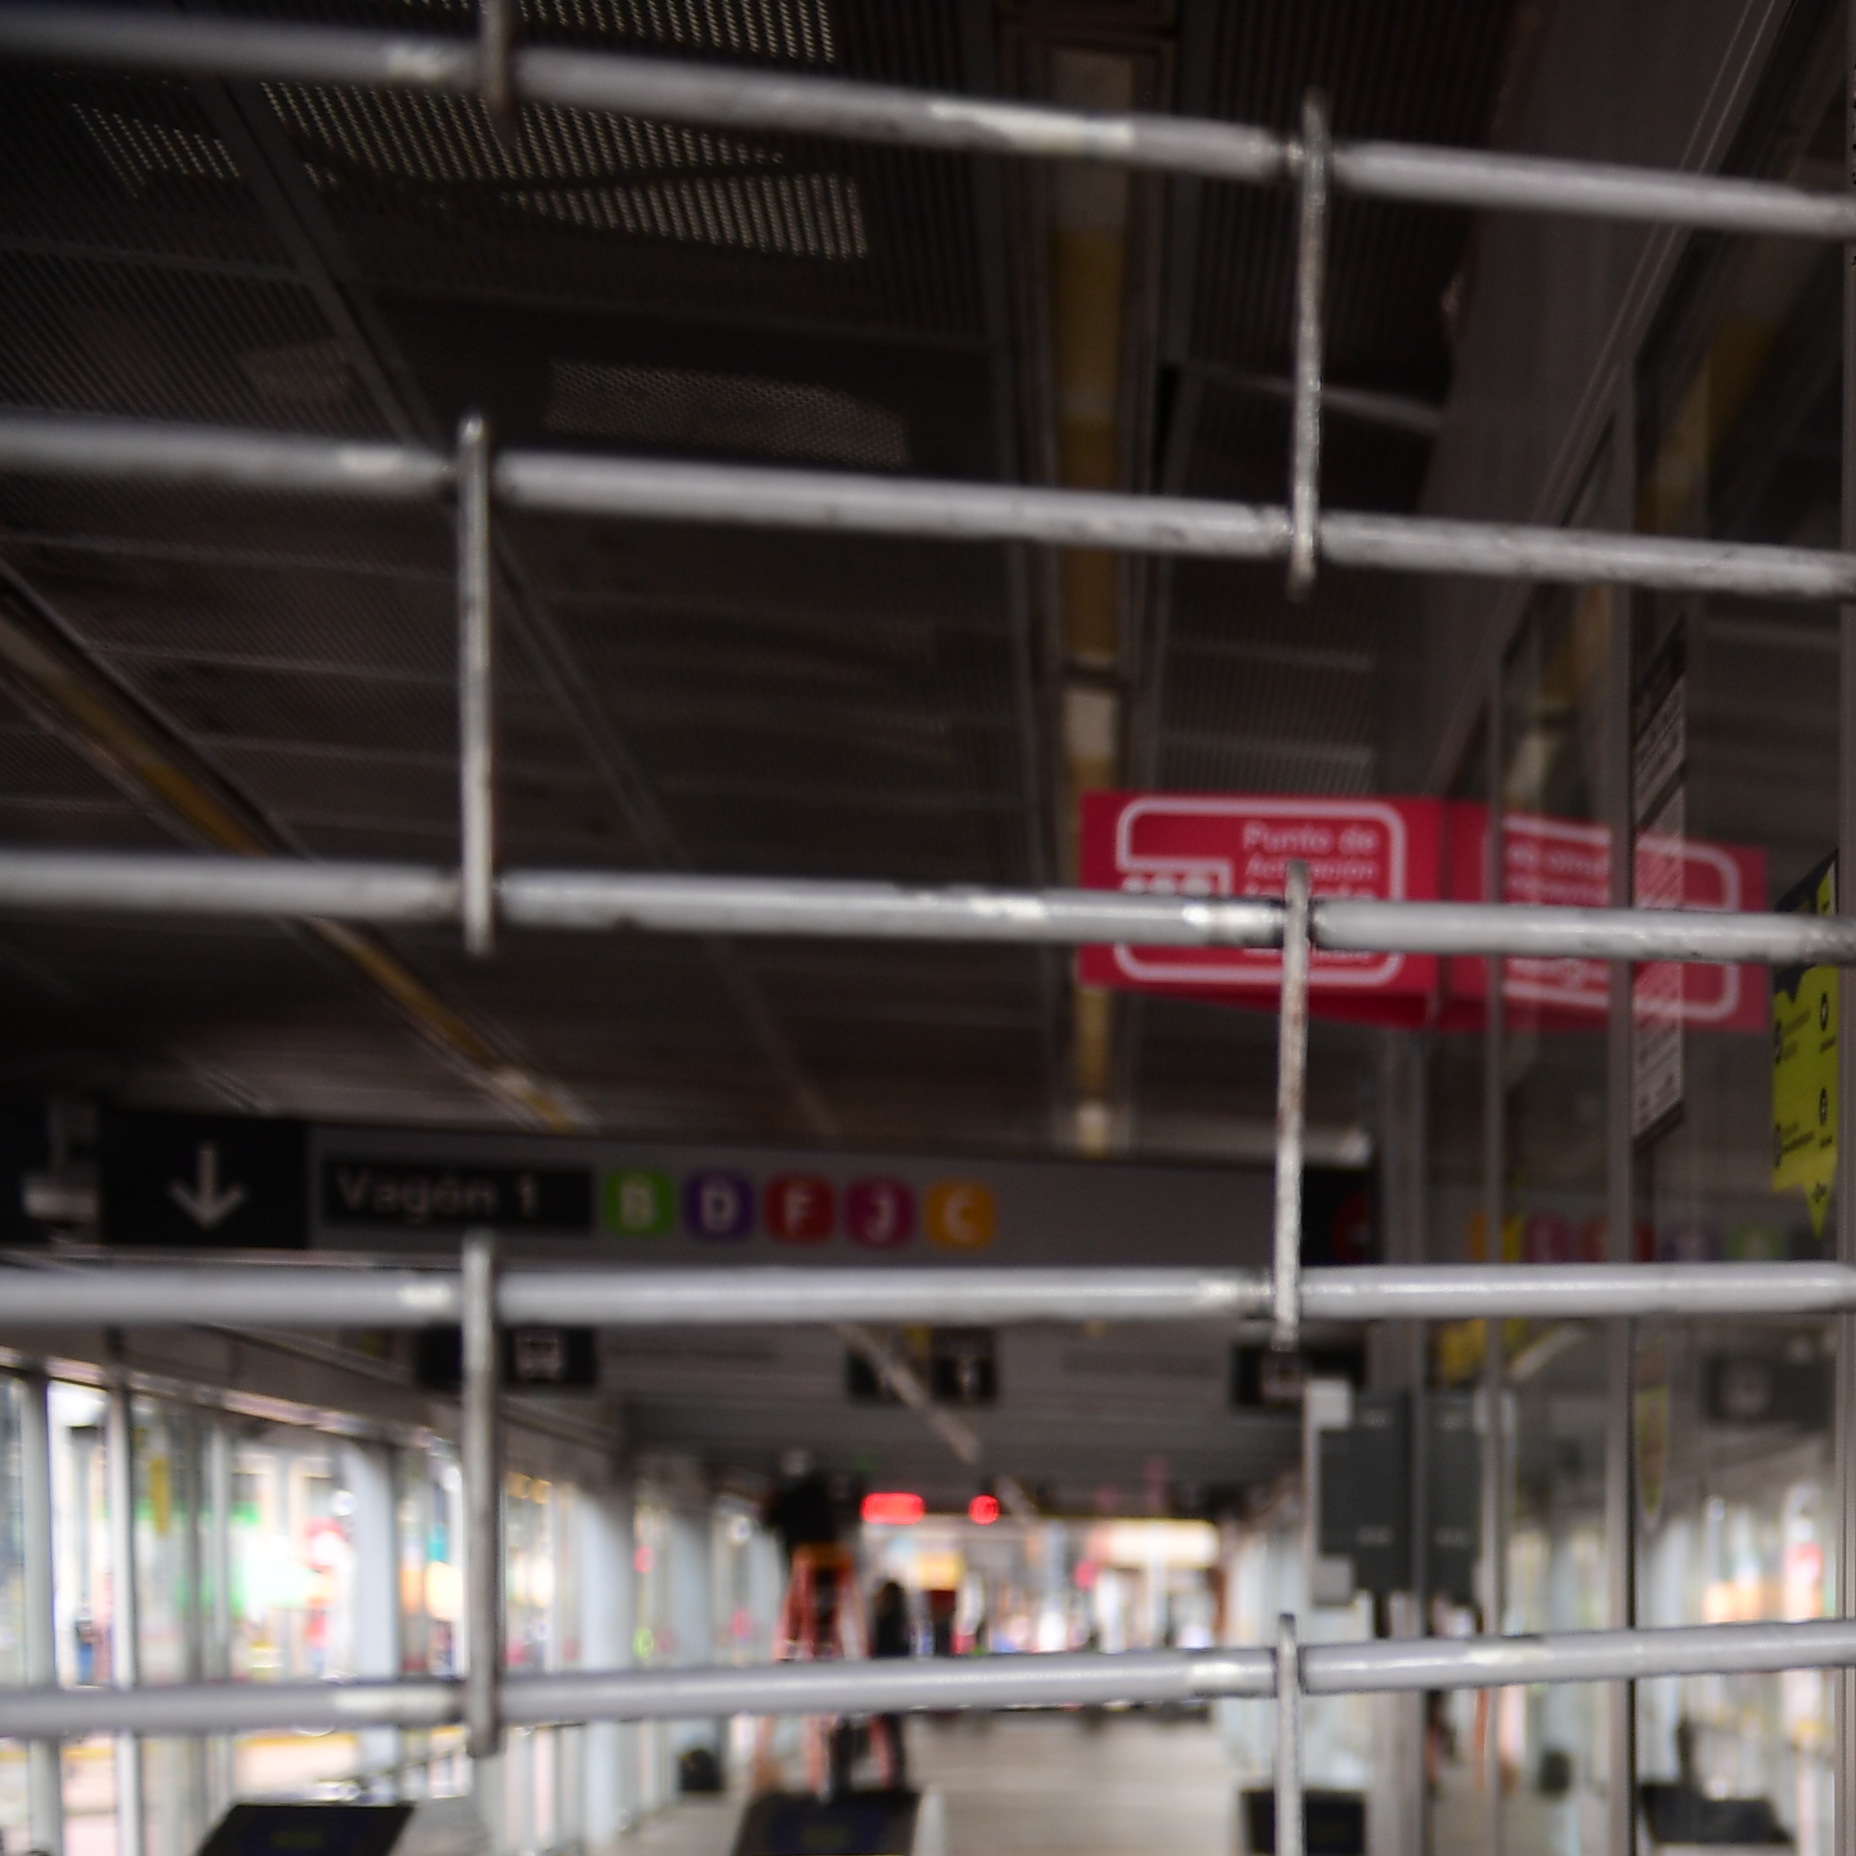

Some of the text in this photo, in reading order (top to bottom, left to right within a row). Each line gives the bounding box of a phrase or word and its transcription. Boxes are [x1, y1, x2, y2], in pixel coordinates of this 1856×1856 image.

[1243, 820, 1380, 855] Punto de
[337, 1165, 538, 1224] Vagón 1
[619, 1174, 654, 1230] B
[701, 1178, 738, 1234] D
[943, 1186, 982, 1243] C
